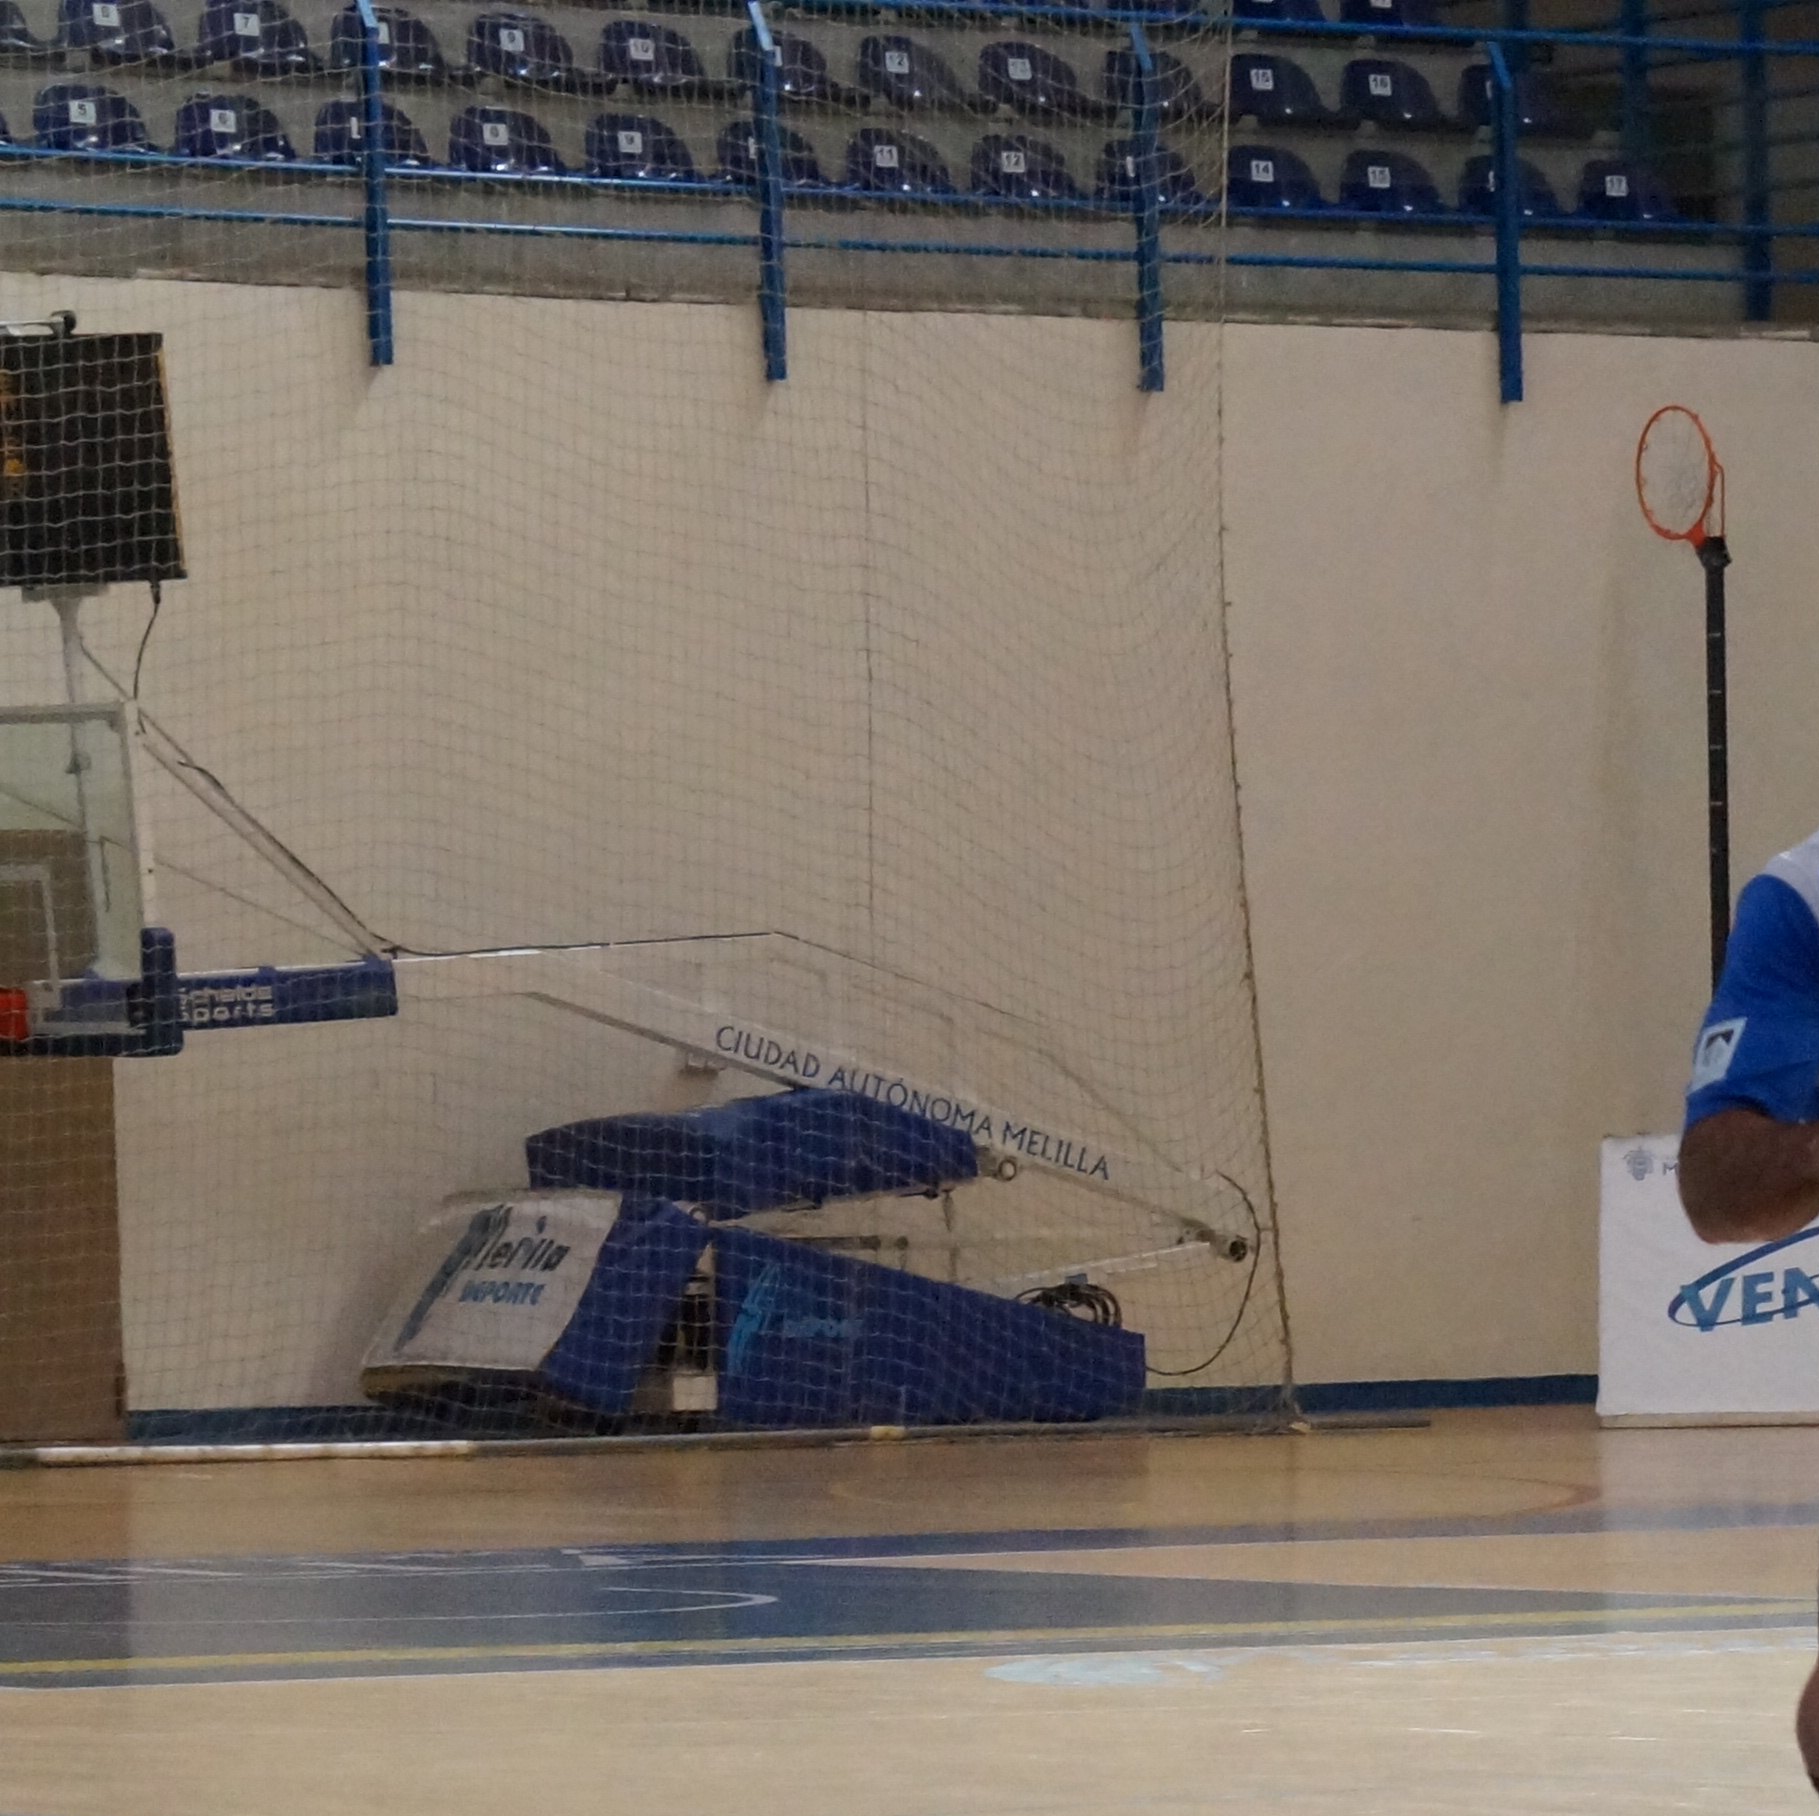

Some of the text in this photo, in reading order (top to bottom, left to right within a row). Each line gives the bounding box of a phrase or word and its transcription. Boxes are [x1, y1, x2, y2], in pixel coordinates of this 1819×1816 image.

[716, 1025, 1111, 1182] CIUDAD AUTÓNOMA MELILLA
